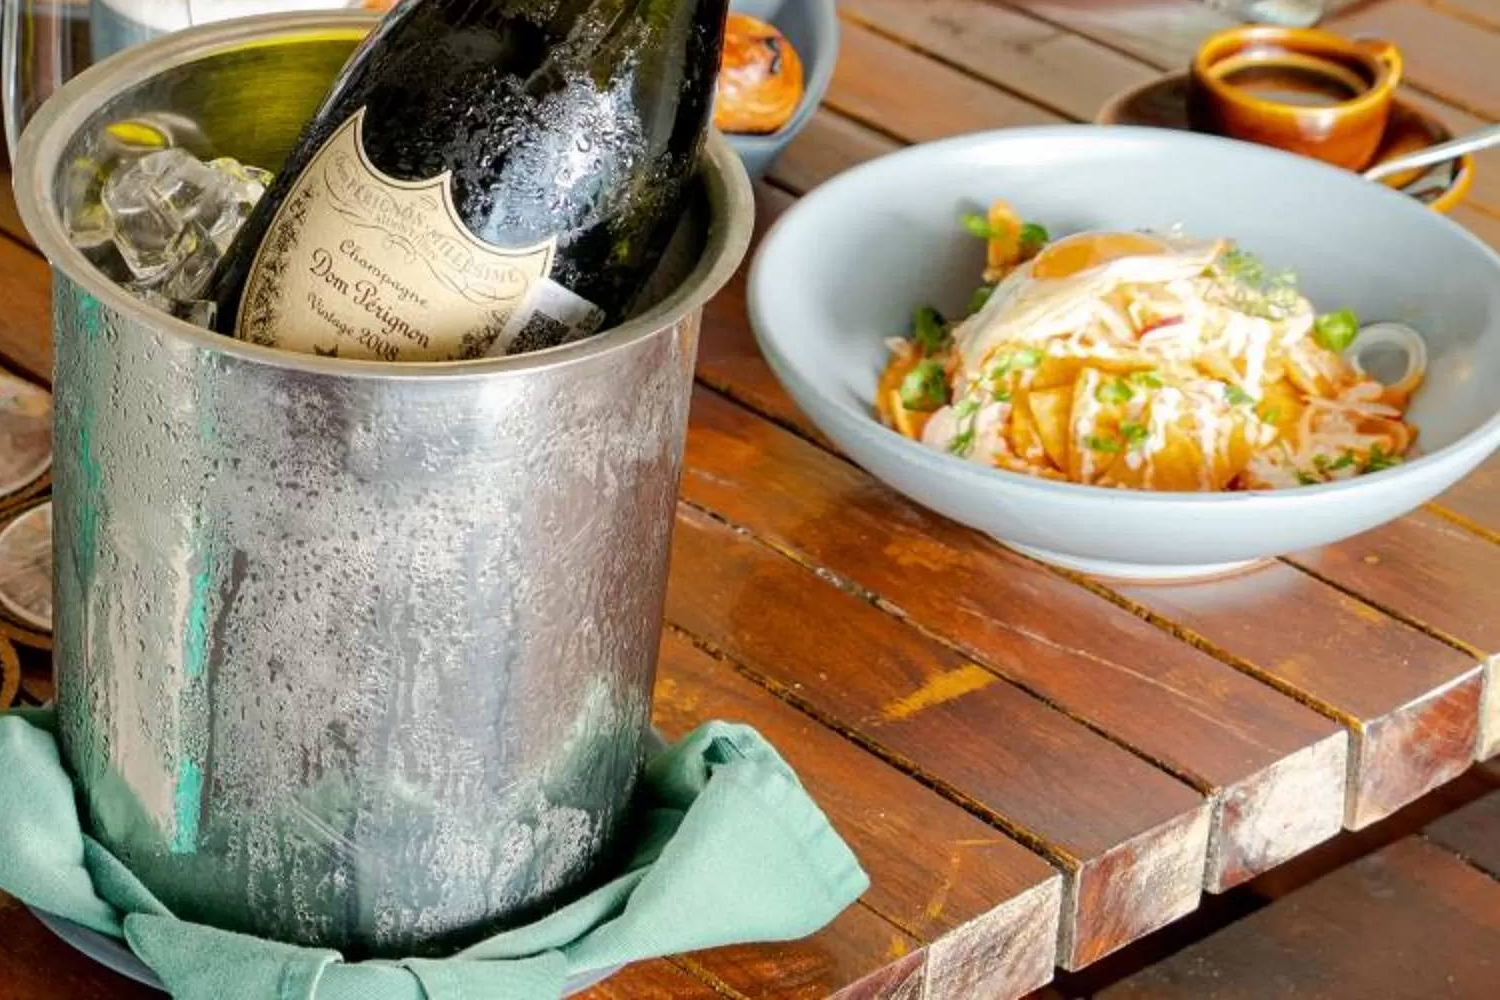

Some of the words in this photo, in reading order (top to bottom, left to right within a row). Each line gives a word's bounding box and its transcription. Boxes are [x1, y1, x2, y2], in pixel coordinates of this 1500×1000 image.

[309, 247, 350, 295] Dom
[353, 280, 430, 349] Pérignon
[339, 239, 428, 306] Champagne
[307, 291, 355, 336] Vintage
[357, 328, 400, 362] 2008
